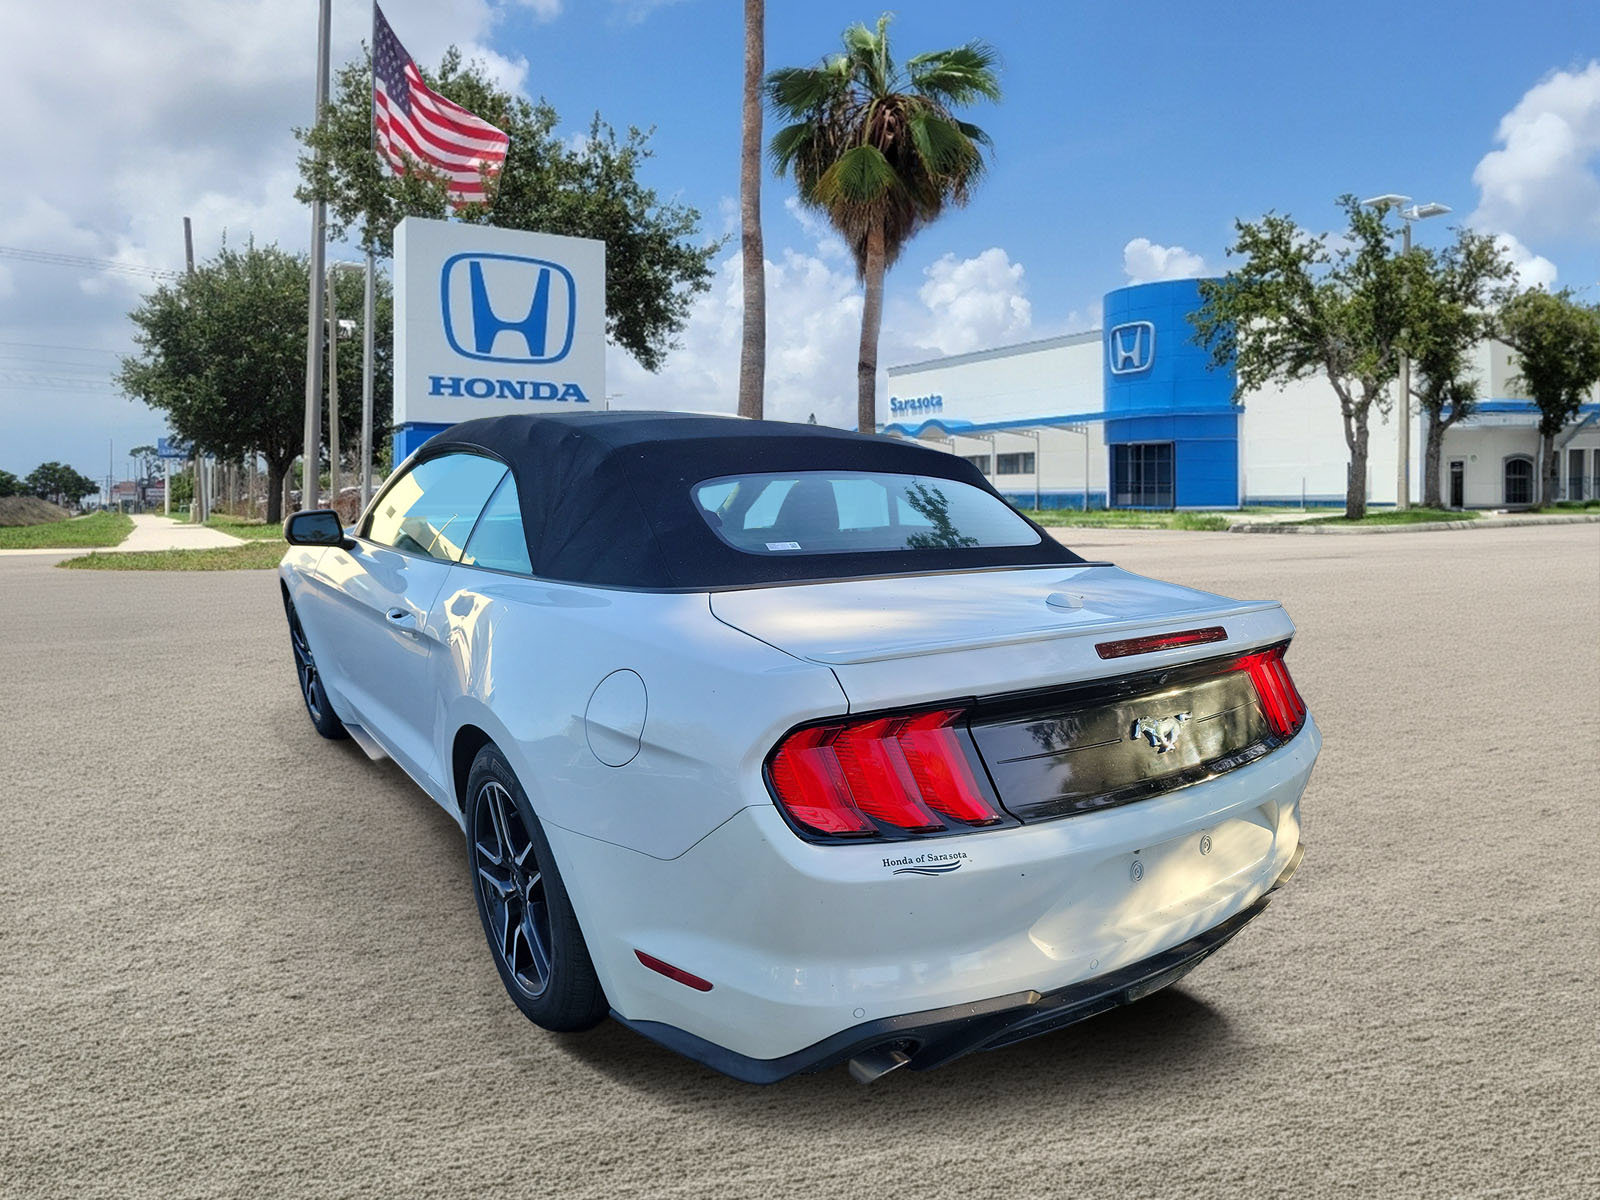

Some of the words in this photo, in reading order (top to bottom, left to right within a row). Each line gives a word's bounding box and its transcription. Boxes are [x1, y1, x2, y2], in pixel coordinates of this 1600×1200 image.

[428, 376, 590, 403] HONDA
[890, 393, 943, 412] Sarasota
[882, 856, 914, 867] Honda
[915, 854, 925, 864] of
[927, 852, 968, 862] Sarasota
